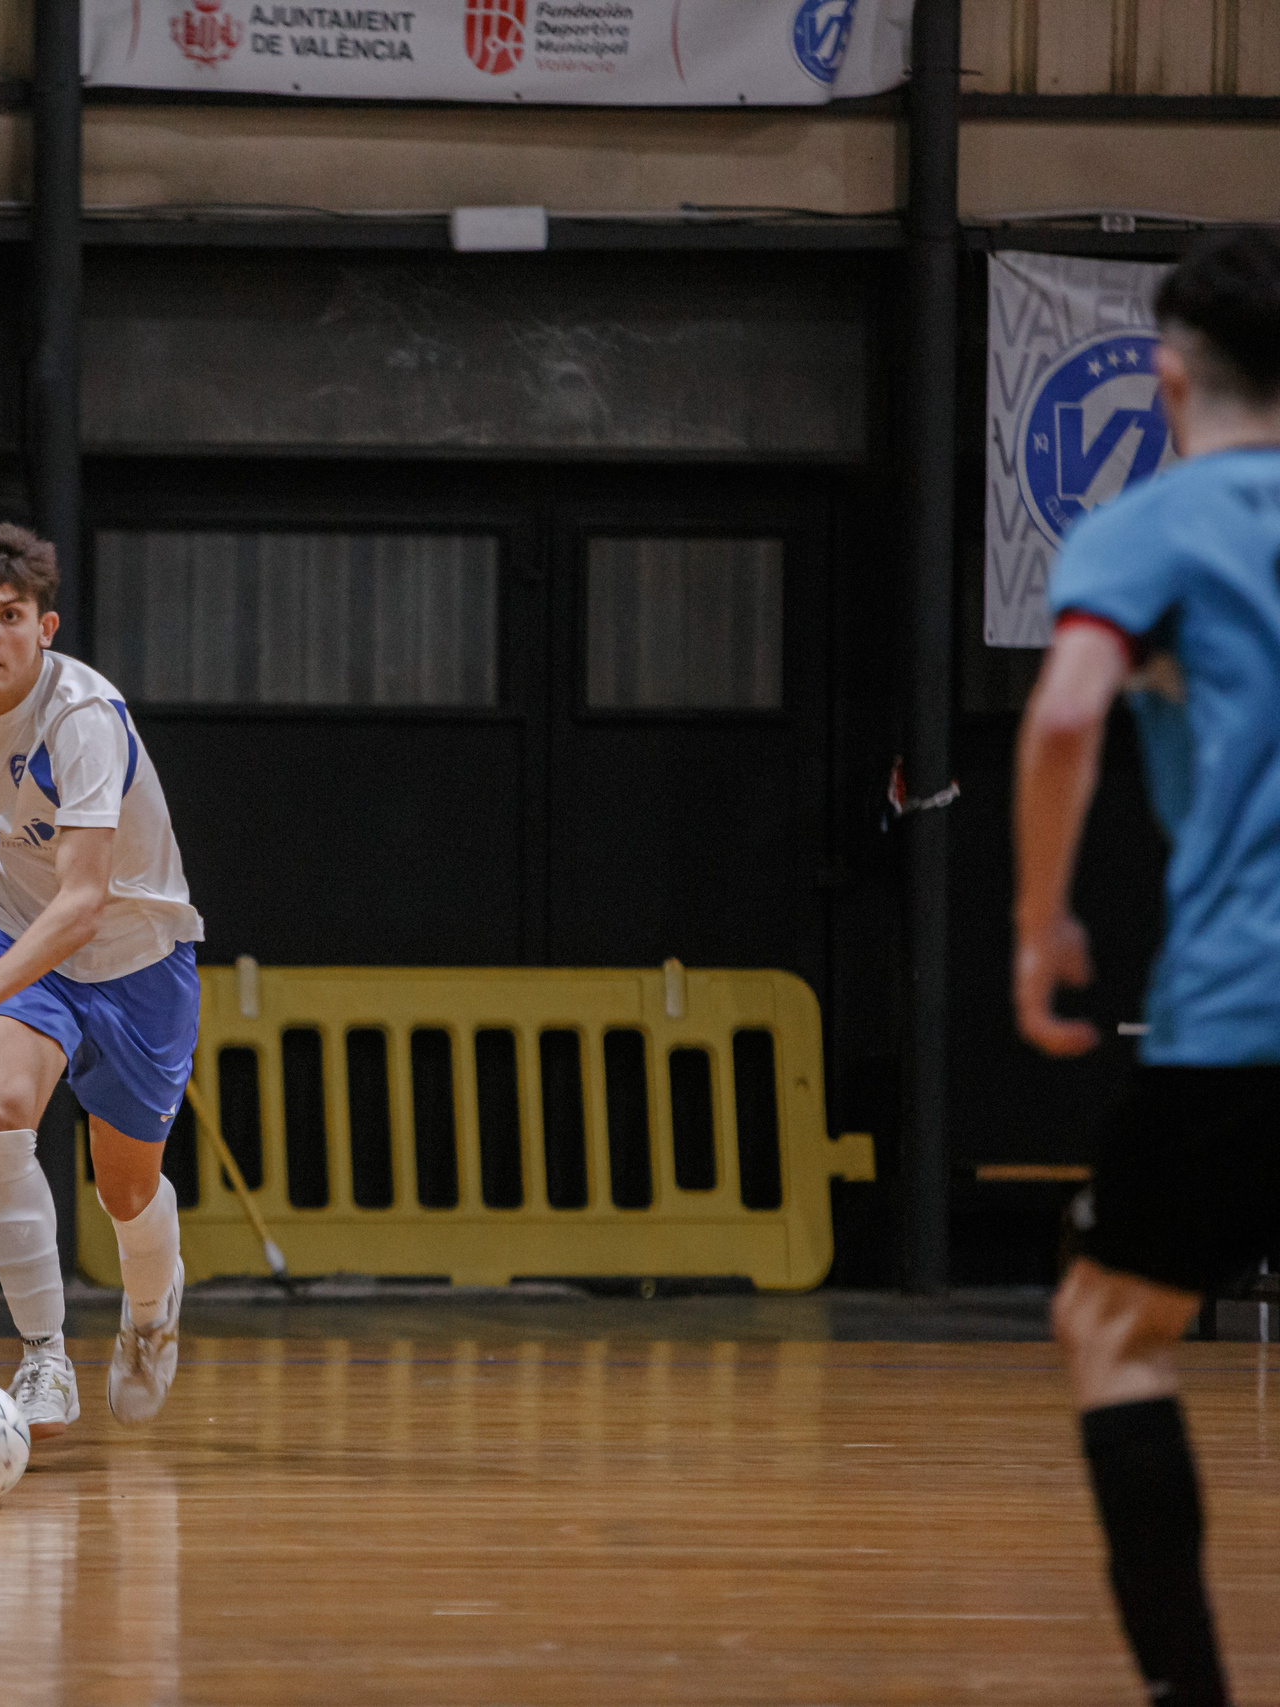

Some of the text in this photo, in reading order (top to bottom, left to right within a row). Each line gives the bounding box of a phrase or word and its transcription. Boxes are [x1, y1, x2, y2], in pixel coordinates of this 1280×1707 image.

[250, 5, 416, 33] AJUNTAMENT
[251, 32, 414, 61] DE VALÈNCIA
